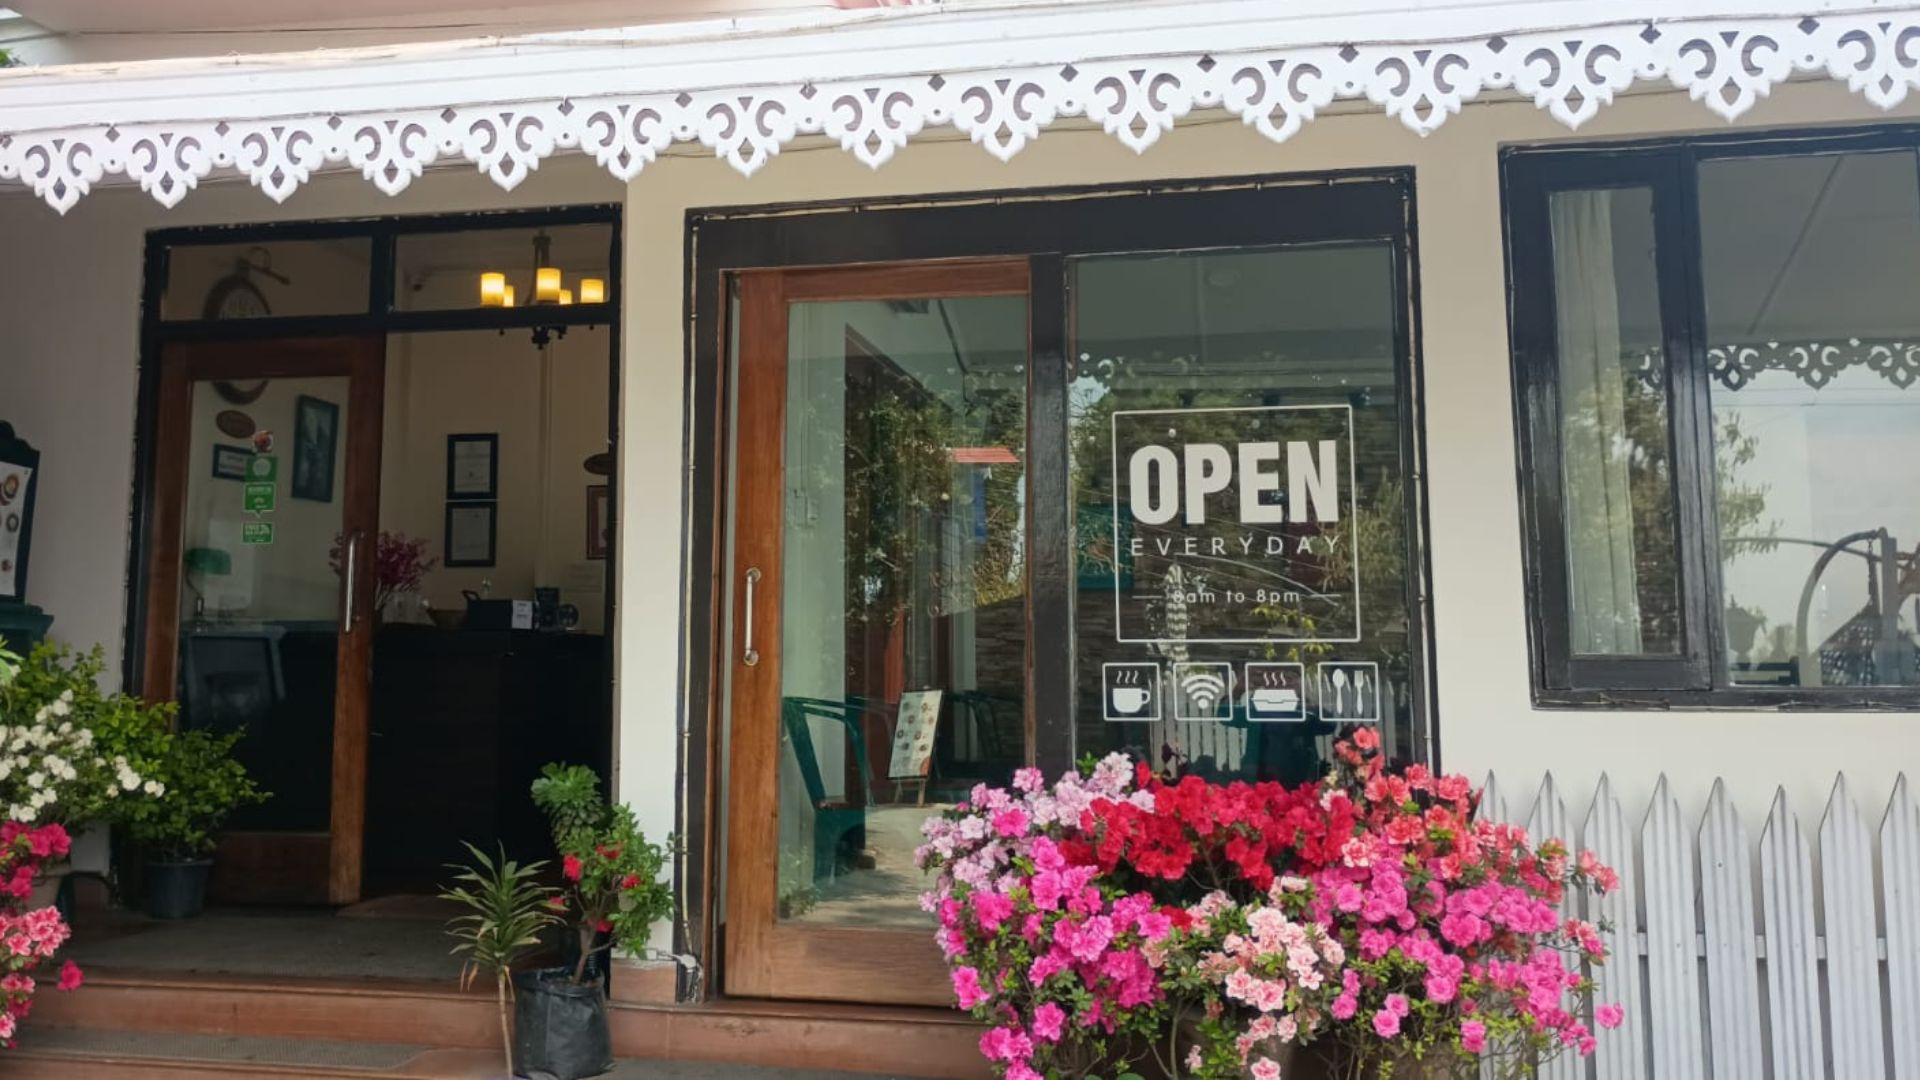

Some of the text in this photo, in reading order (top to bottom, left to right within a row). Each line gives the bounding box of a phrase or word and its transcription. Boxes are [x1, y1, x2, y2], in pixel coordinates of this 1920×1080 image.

[1130, 440, 1339, 524] OPEN
[1131, 536, 1339, 556] EVERYDAY
[1226, 590, 1245, 603] to
[1256, 589, 1300, 605] 8pm
